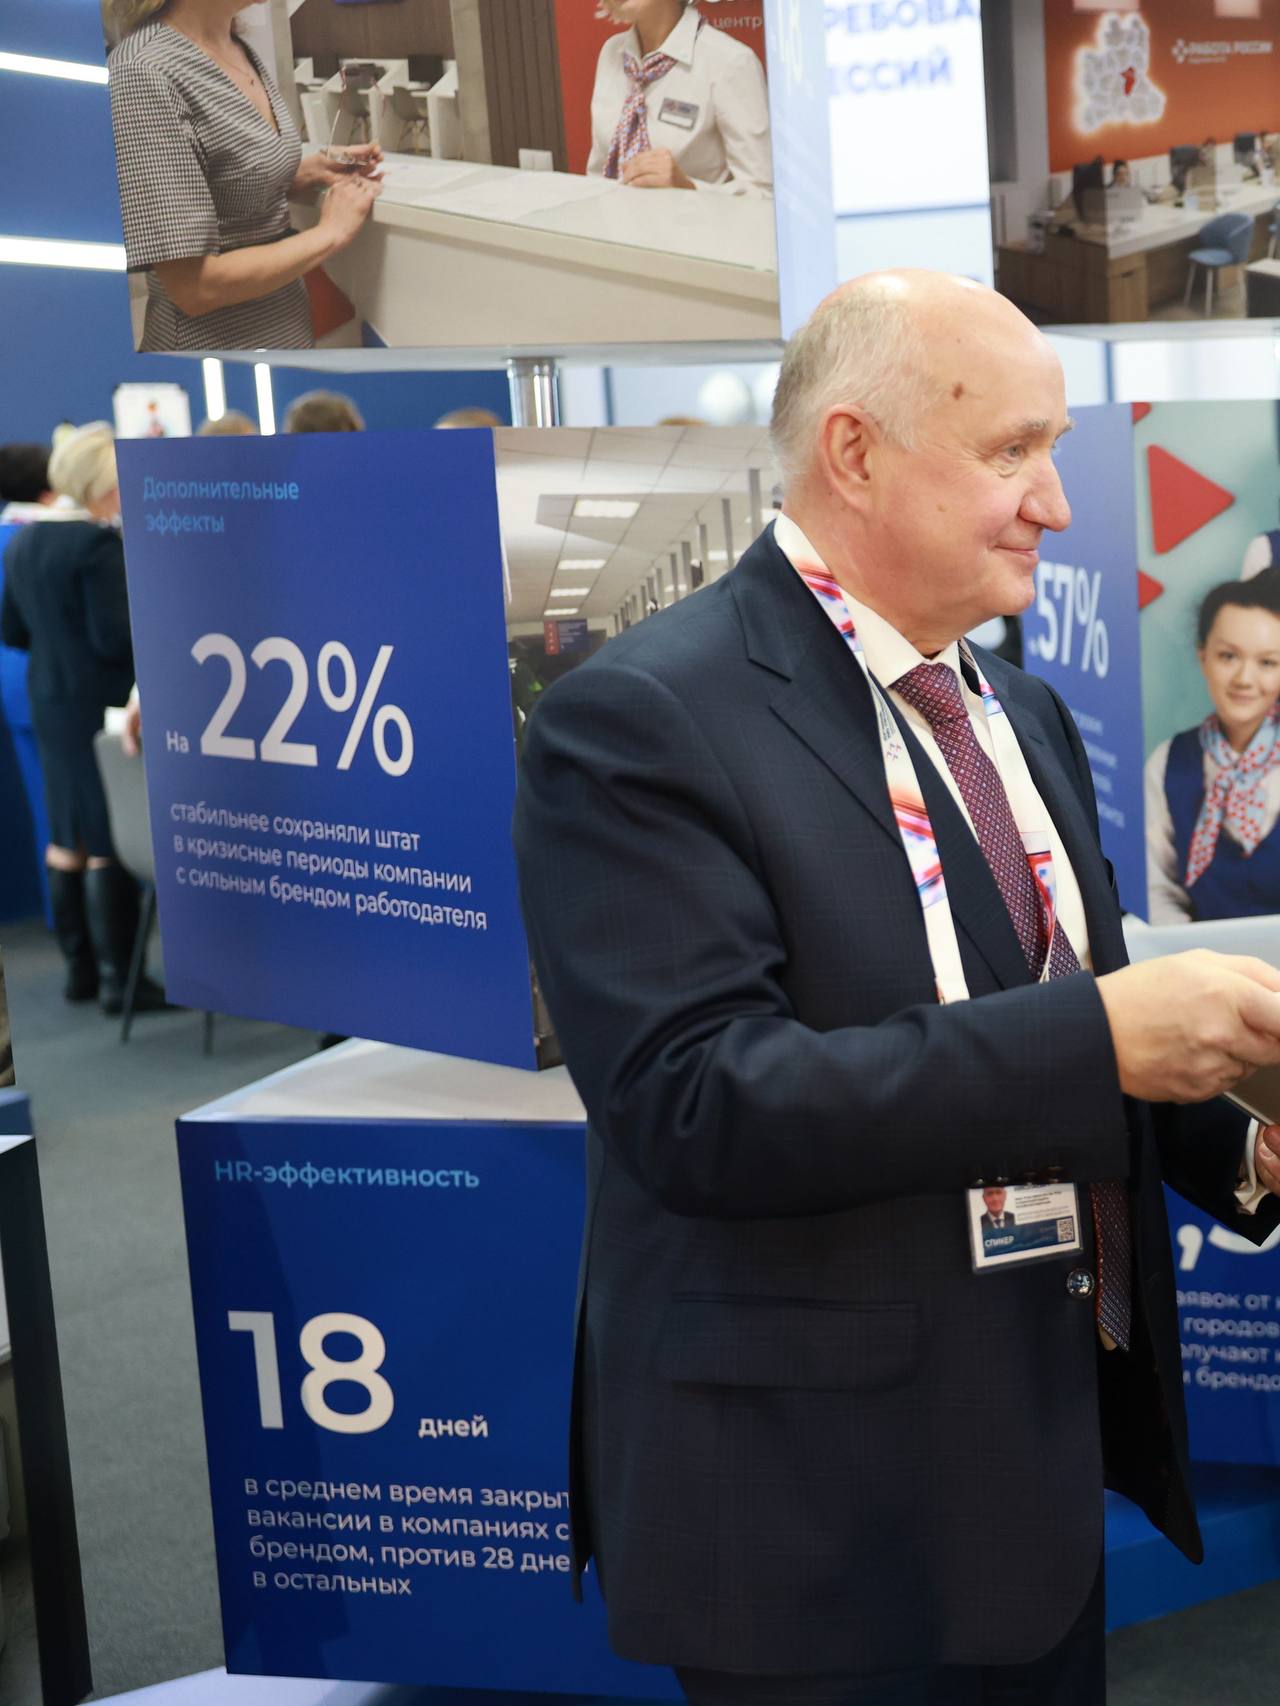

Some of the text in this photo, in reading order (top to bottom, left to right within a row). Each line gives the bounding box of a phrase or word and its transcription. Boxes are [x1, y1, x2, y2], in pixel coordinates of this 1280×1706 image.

[144, 475, 299, 501] Дополнительные
[145, 509, 225, 536] эффекты
[1037, 560, 1109, 679] 57%
[166, 633, 414, 777] На 22%
[170, 801, 420, 851] стабильнее сохраняли штат
[174, 835, 472, 893] в кризисные периоды компании
[176, 866, 487, 930] с сильным брендом работодателя
[215, 1160, 480, 1189] HR-эффективность
[1244, 1294, 1270, 1311] от
[1184, 1317, 1280, 1338] городов
[227, 1310, 489, 1438] 18 дней
[244, 1478, 259, 1495] в
[265, 1479, 381, 1501] среднем
[389, 1484, 473, 1507] время
[248, 1509, 371, 1531] вакансии
[379, 1515, 394, 1532] в
[402, 1516, 549, 1540] компаниях
[250, 1534, 589, 1574] брендом, против 28 дне
[253, 1571, 411, 1595] в остальных
